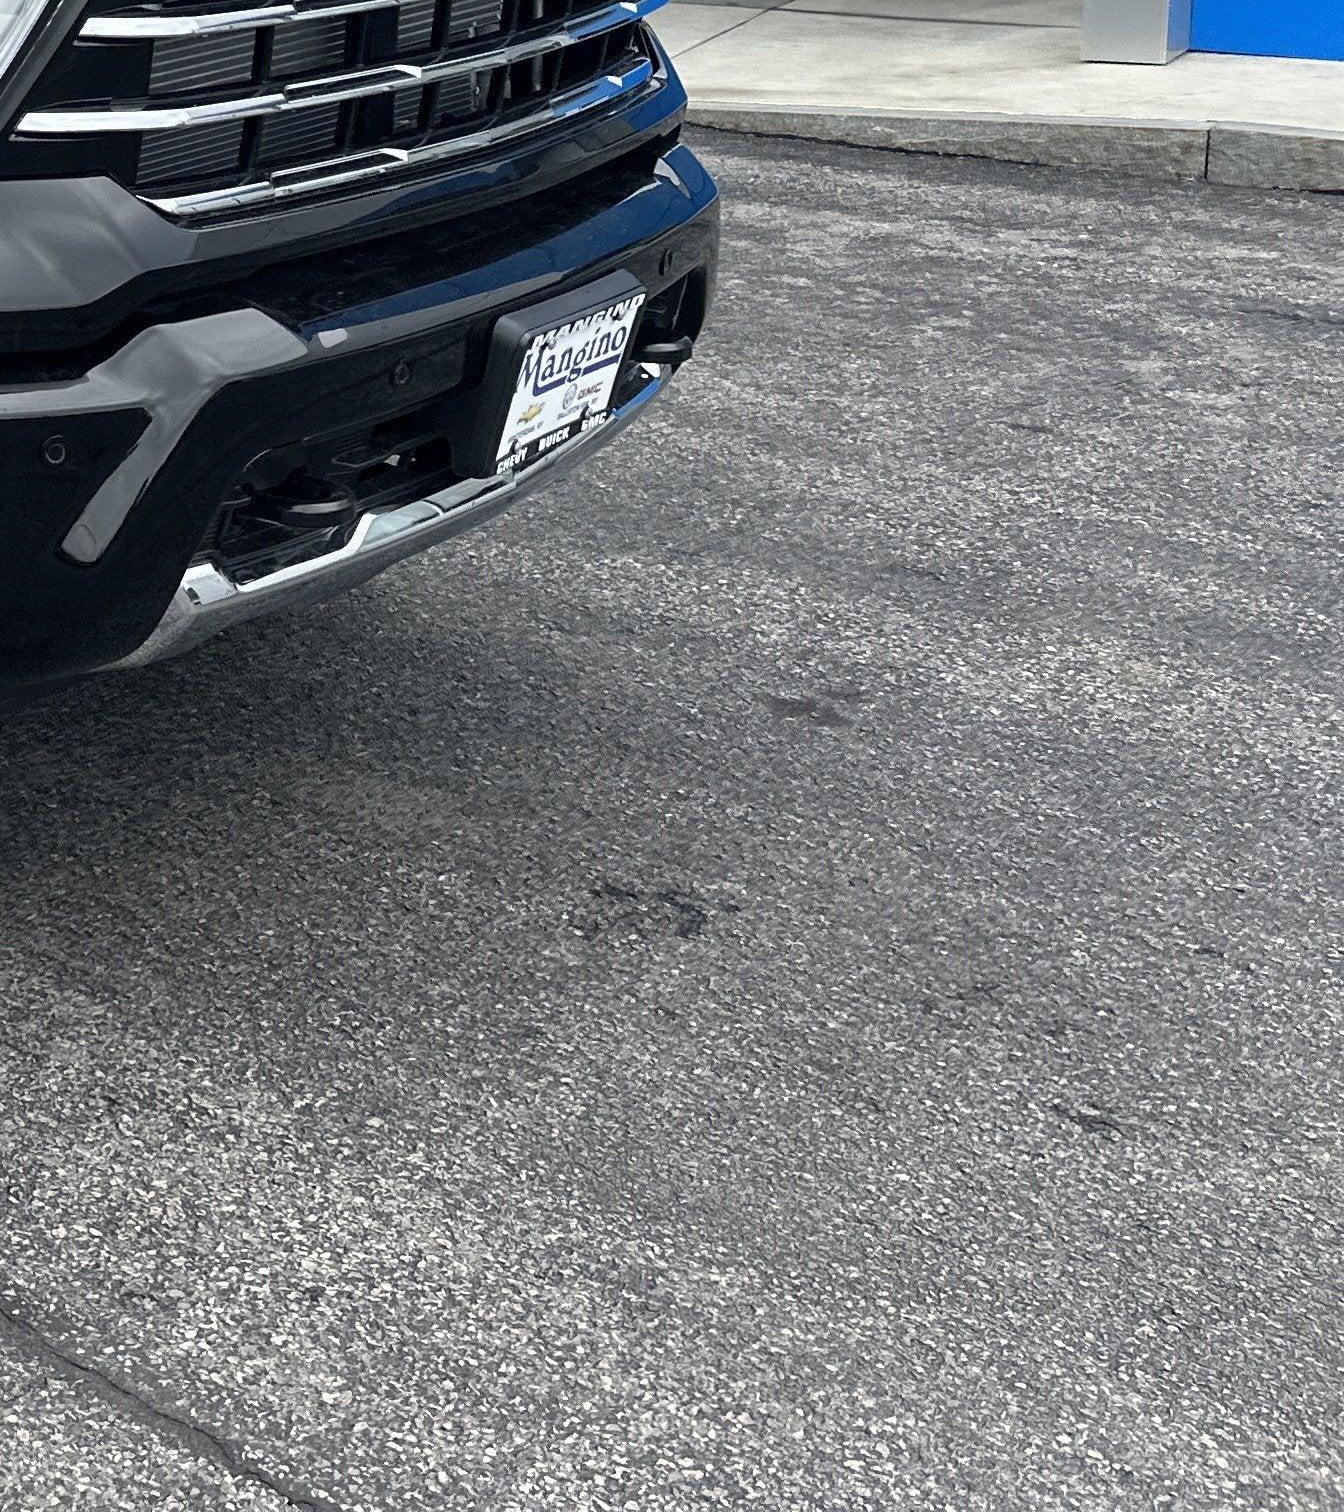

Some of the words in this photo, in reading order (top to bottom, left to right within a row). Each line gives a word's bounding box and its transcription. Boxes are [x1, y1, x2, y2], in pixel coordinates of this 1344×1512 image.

[517, 326, 628, 392] Mangino
[496, 446, 529, 475] CHEVY
[538, 426, 571, 452] BUICK
[580, 412, 608, 433] GMC
